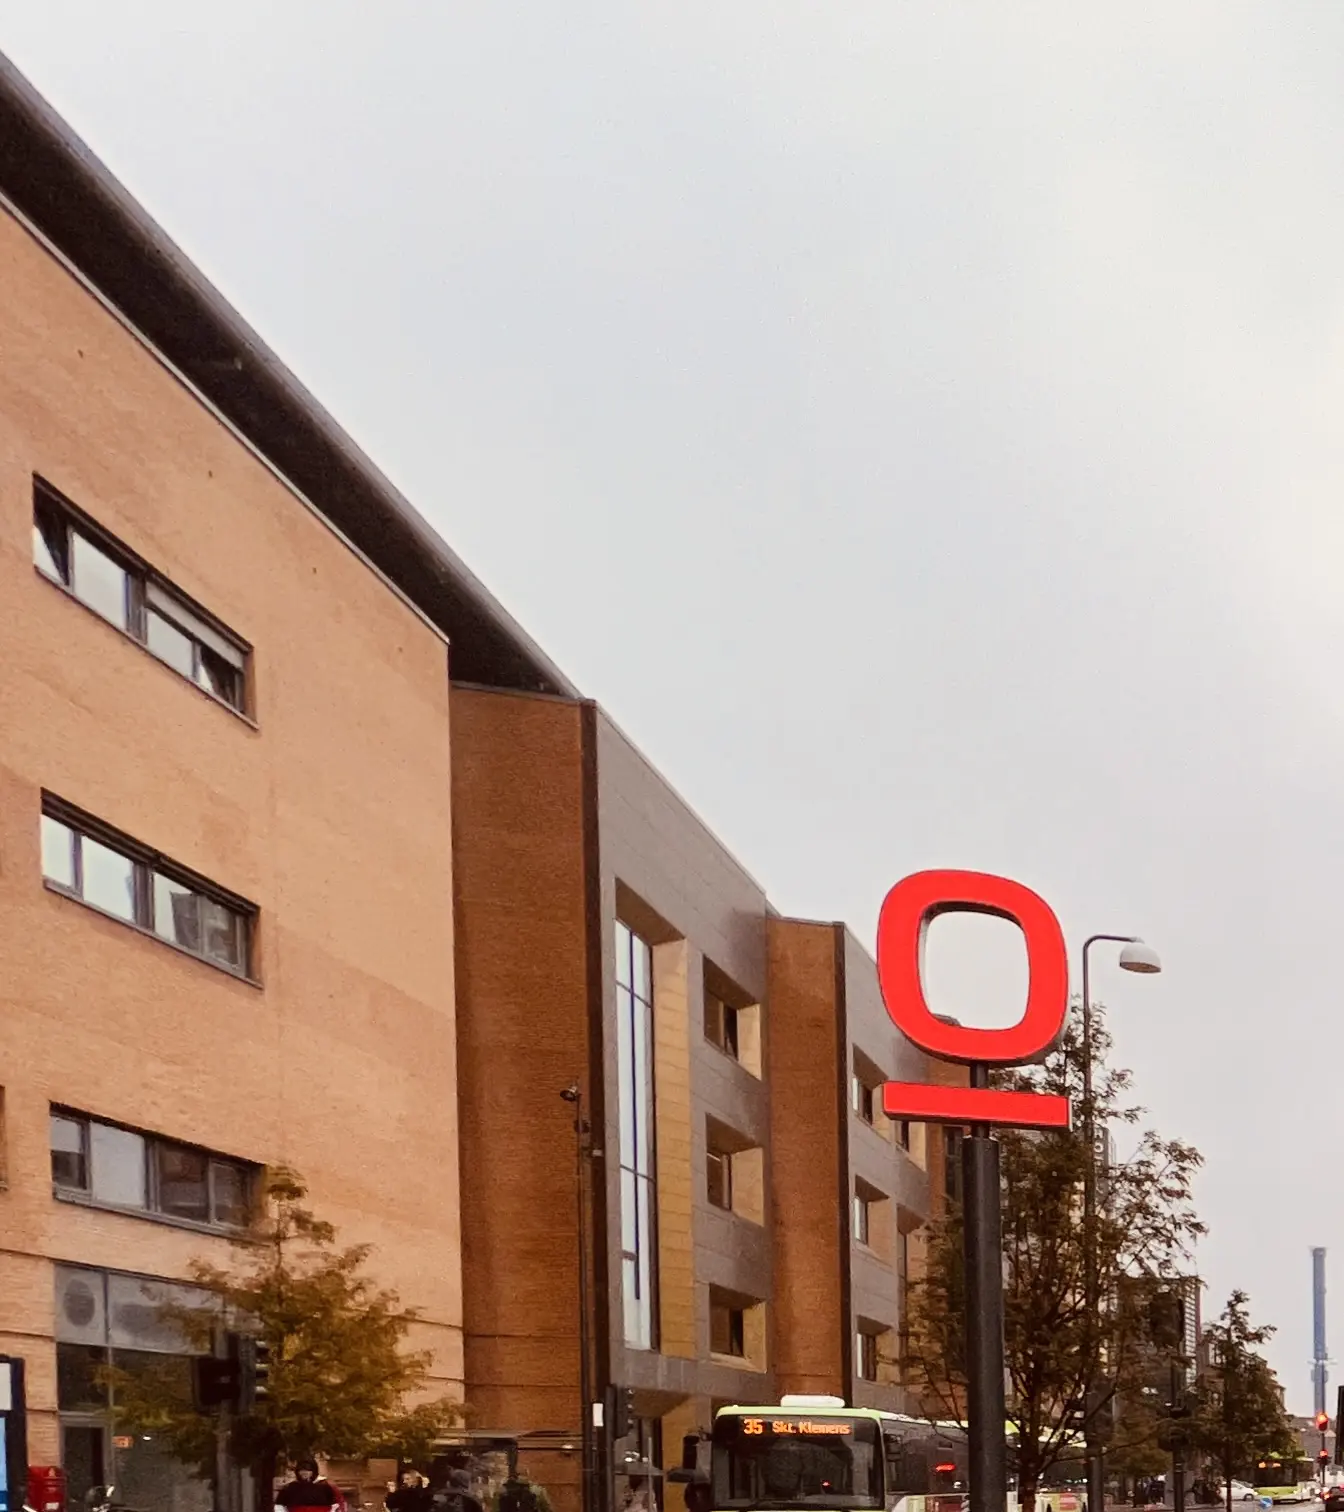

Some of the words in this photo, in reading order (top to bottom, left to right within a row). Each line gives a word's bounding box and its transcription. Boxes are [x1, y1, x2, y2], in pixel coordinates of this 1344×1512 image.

[743, 1418, 764, 1435] 35
[772, 1420, 797, 1434] Skt.
[799, 1421, 851, 1435] Klemens
